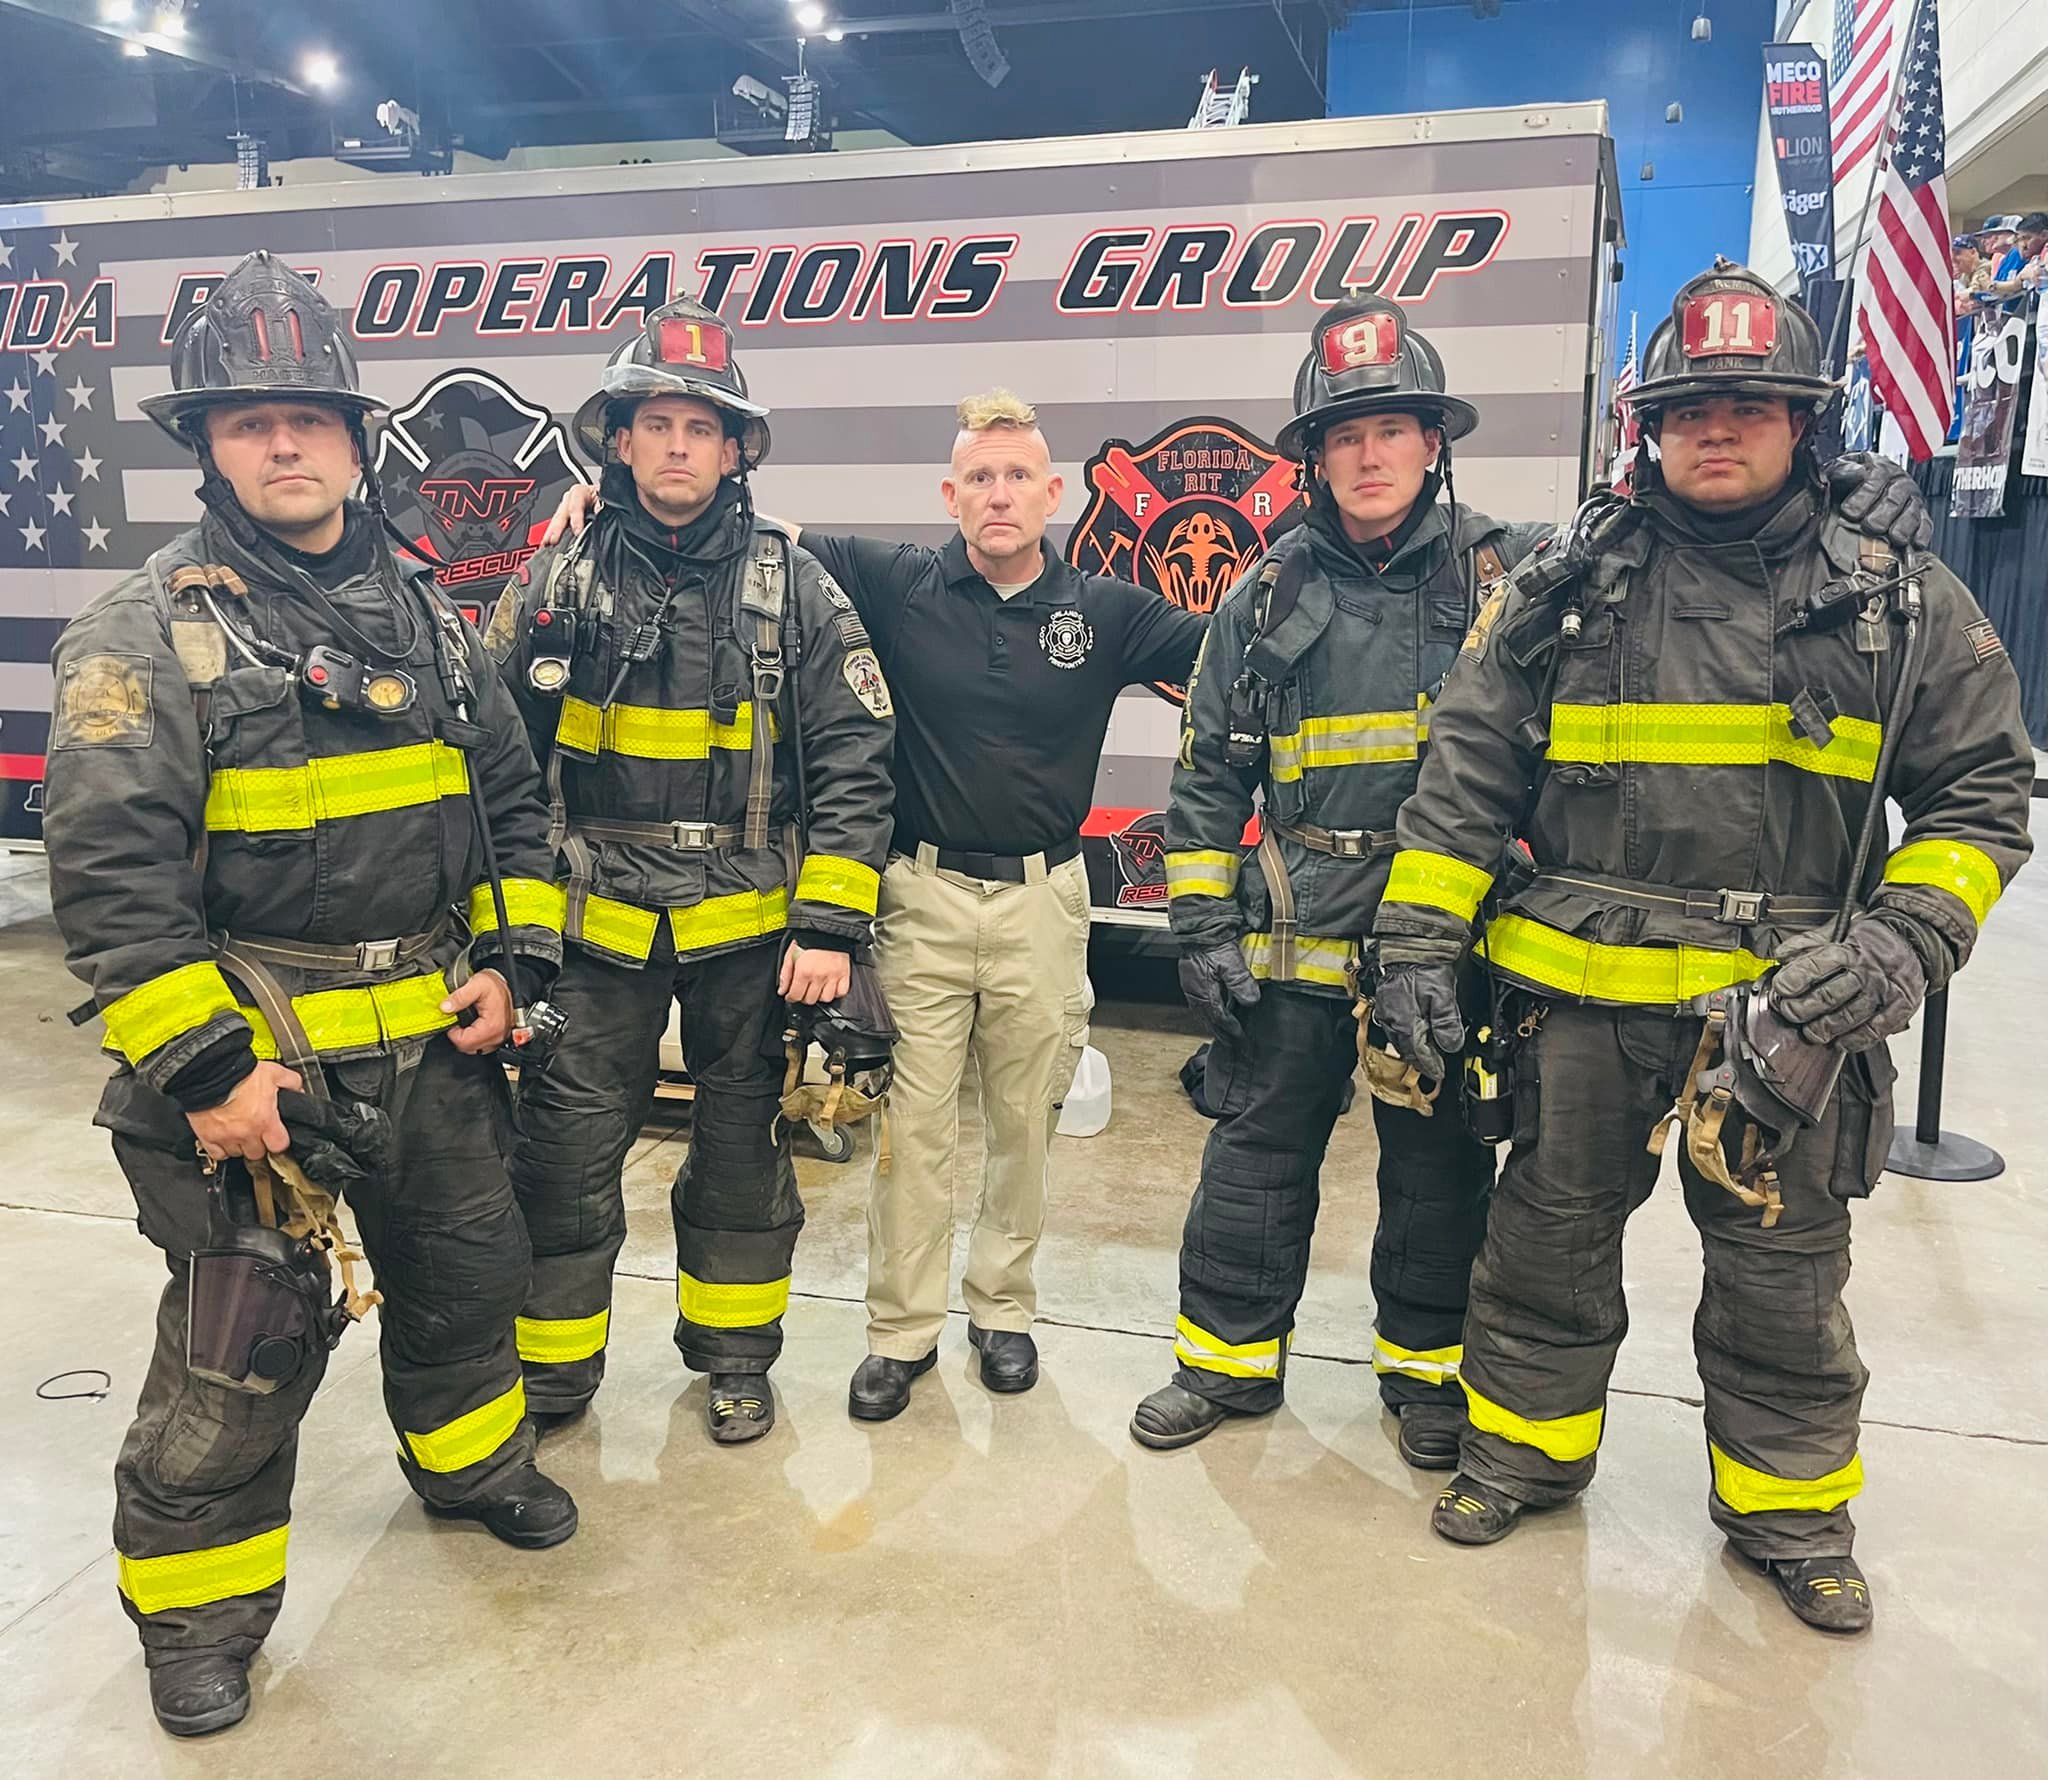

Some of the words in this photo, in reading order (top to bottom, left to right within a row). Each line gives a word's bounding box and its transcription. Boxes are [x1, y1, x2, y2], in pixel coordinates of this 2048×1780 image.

[1766, 61, 1821, 83] MECO
[1768, 81, 1822, 106] FIRE
[1786, 136, 1823, 157] LION
[352, 233, 1020, 341] OPERATIONS
[1054, 209, 1512, 314] GROUP
[1701, 301, 1753, 349] 11
[685, 324, 706, 363] 1
[1342, 321, 1378, 363] 9
[1157, 450, 1251, 472] FLORIDA
[1184, 473, 1223, 493] RIT
[418, 479, 536, 518] TNT
[1134, 493, 1153, 517] F
[1252, 493, 1273, 517] R
[1121, 886, 1169, 904] RES
